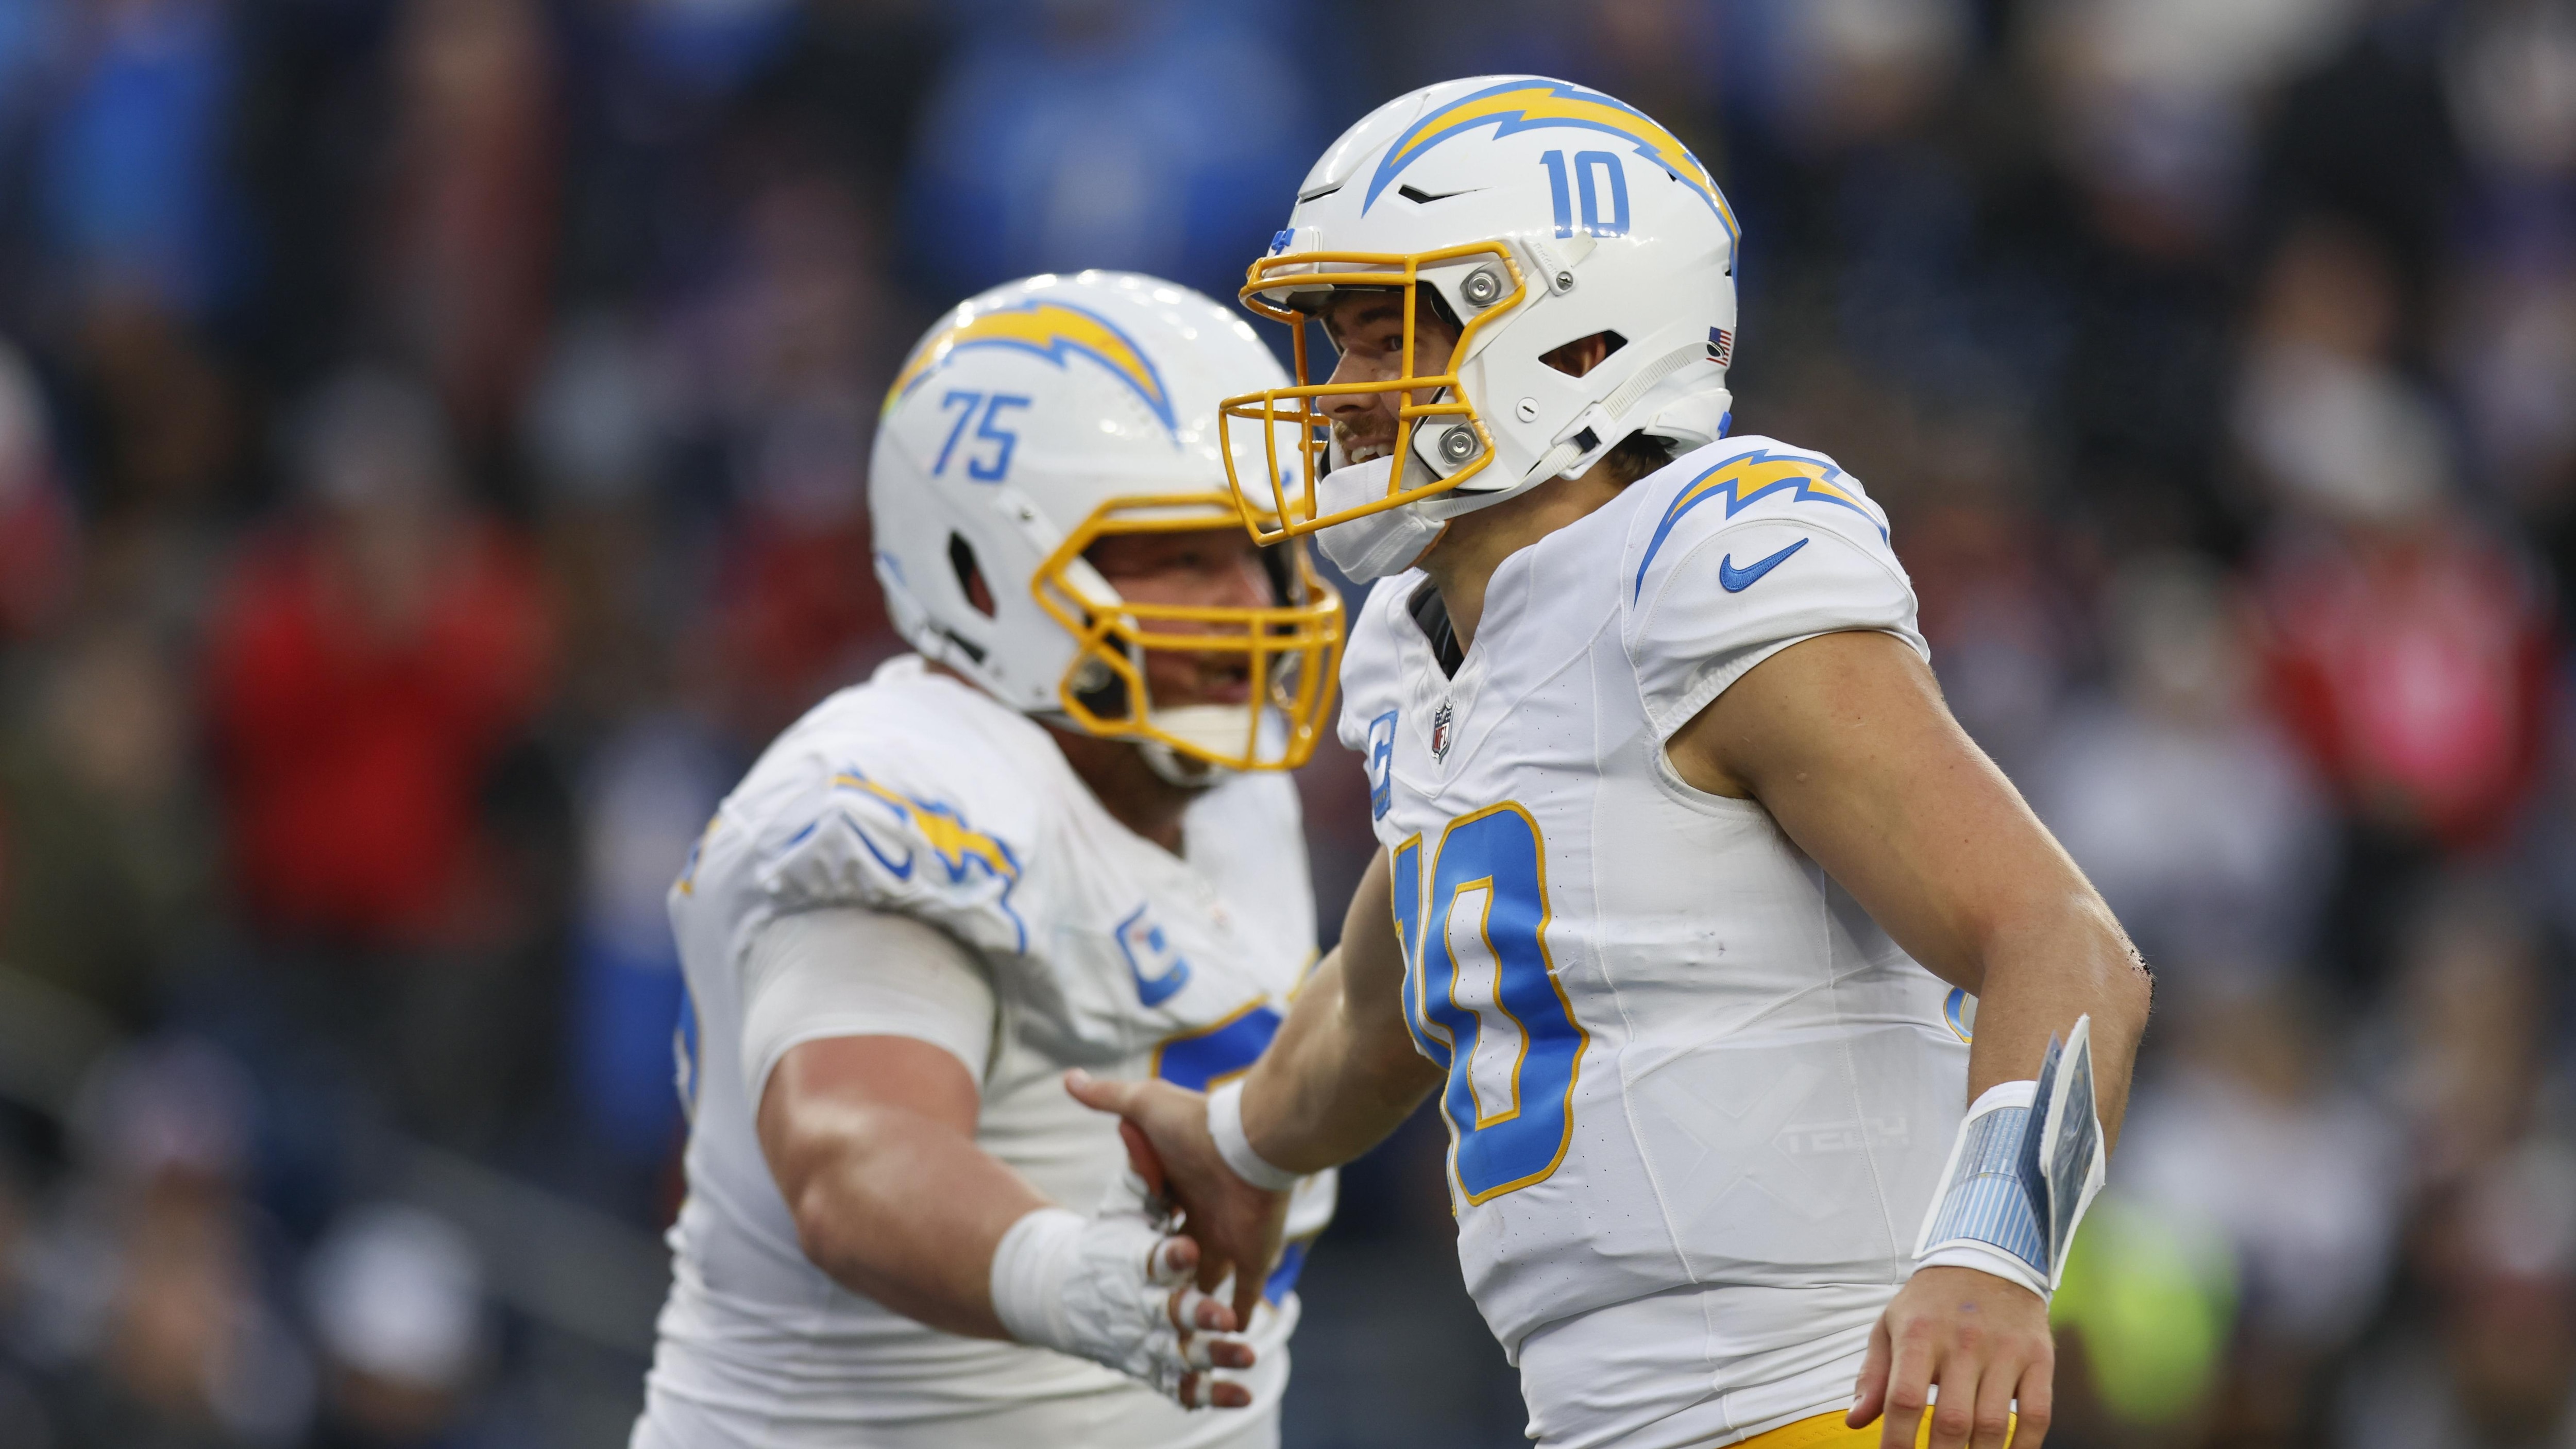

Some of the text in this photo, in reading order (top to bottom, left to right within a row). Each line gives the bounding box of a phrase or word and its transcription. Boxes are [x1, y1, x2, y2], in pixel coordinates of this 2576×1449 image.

[1539, 150, 1630, 238] 10
[933, 390, 1032, 481] 75
[1369, 719, 1391, 791] C
[1434, 725, 1448, 751] NFL
[1391, 800, 1590, 1218] 10
